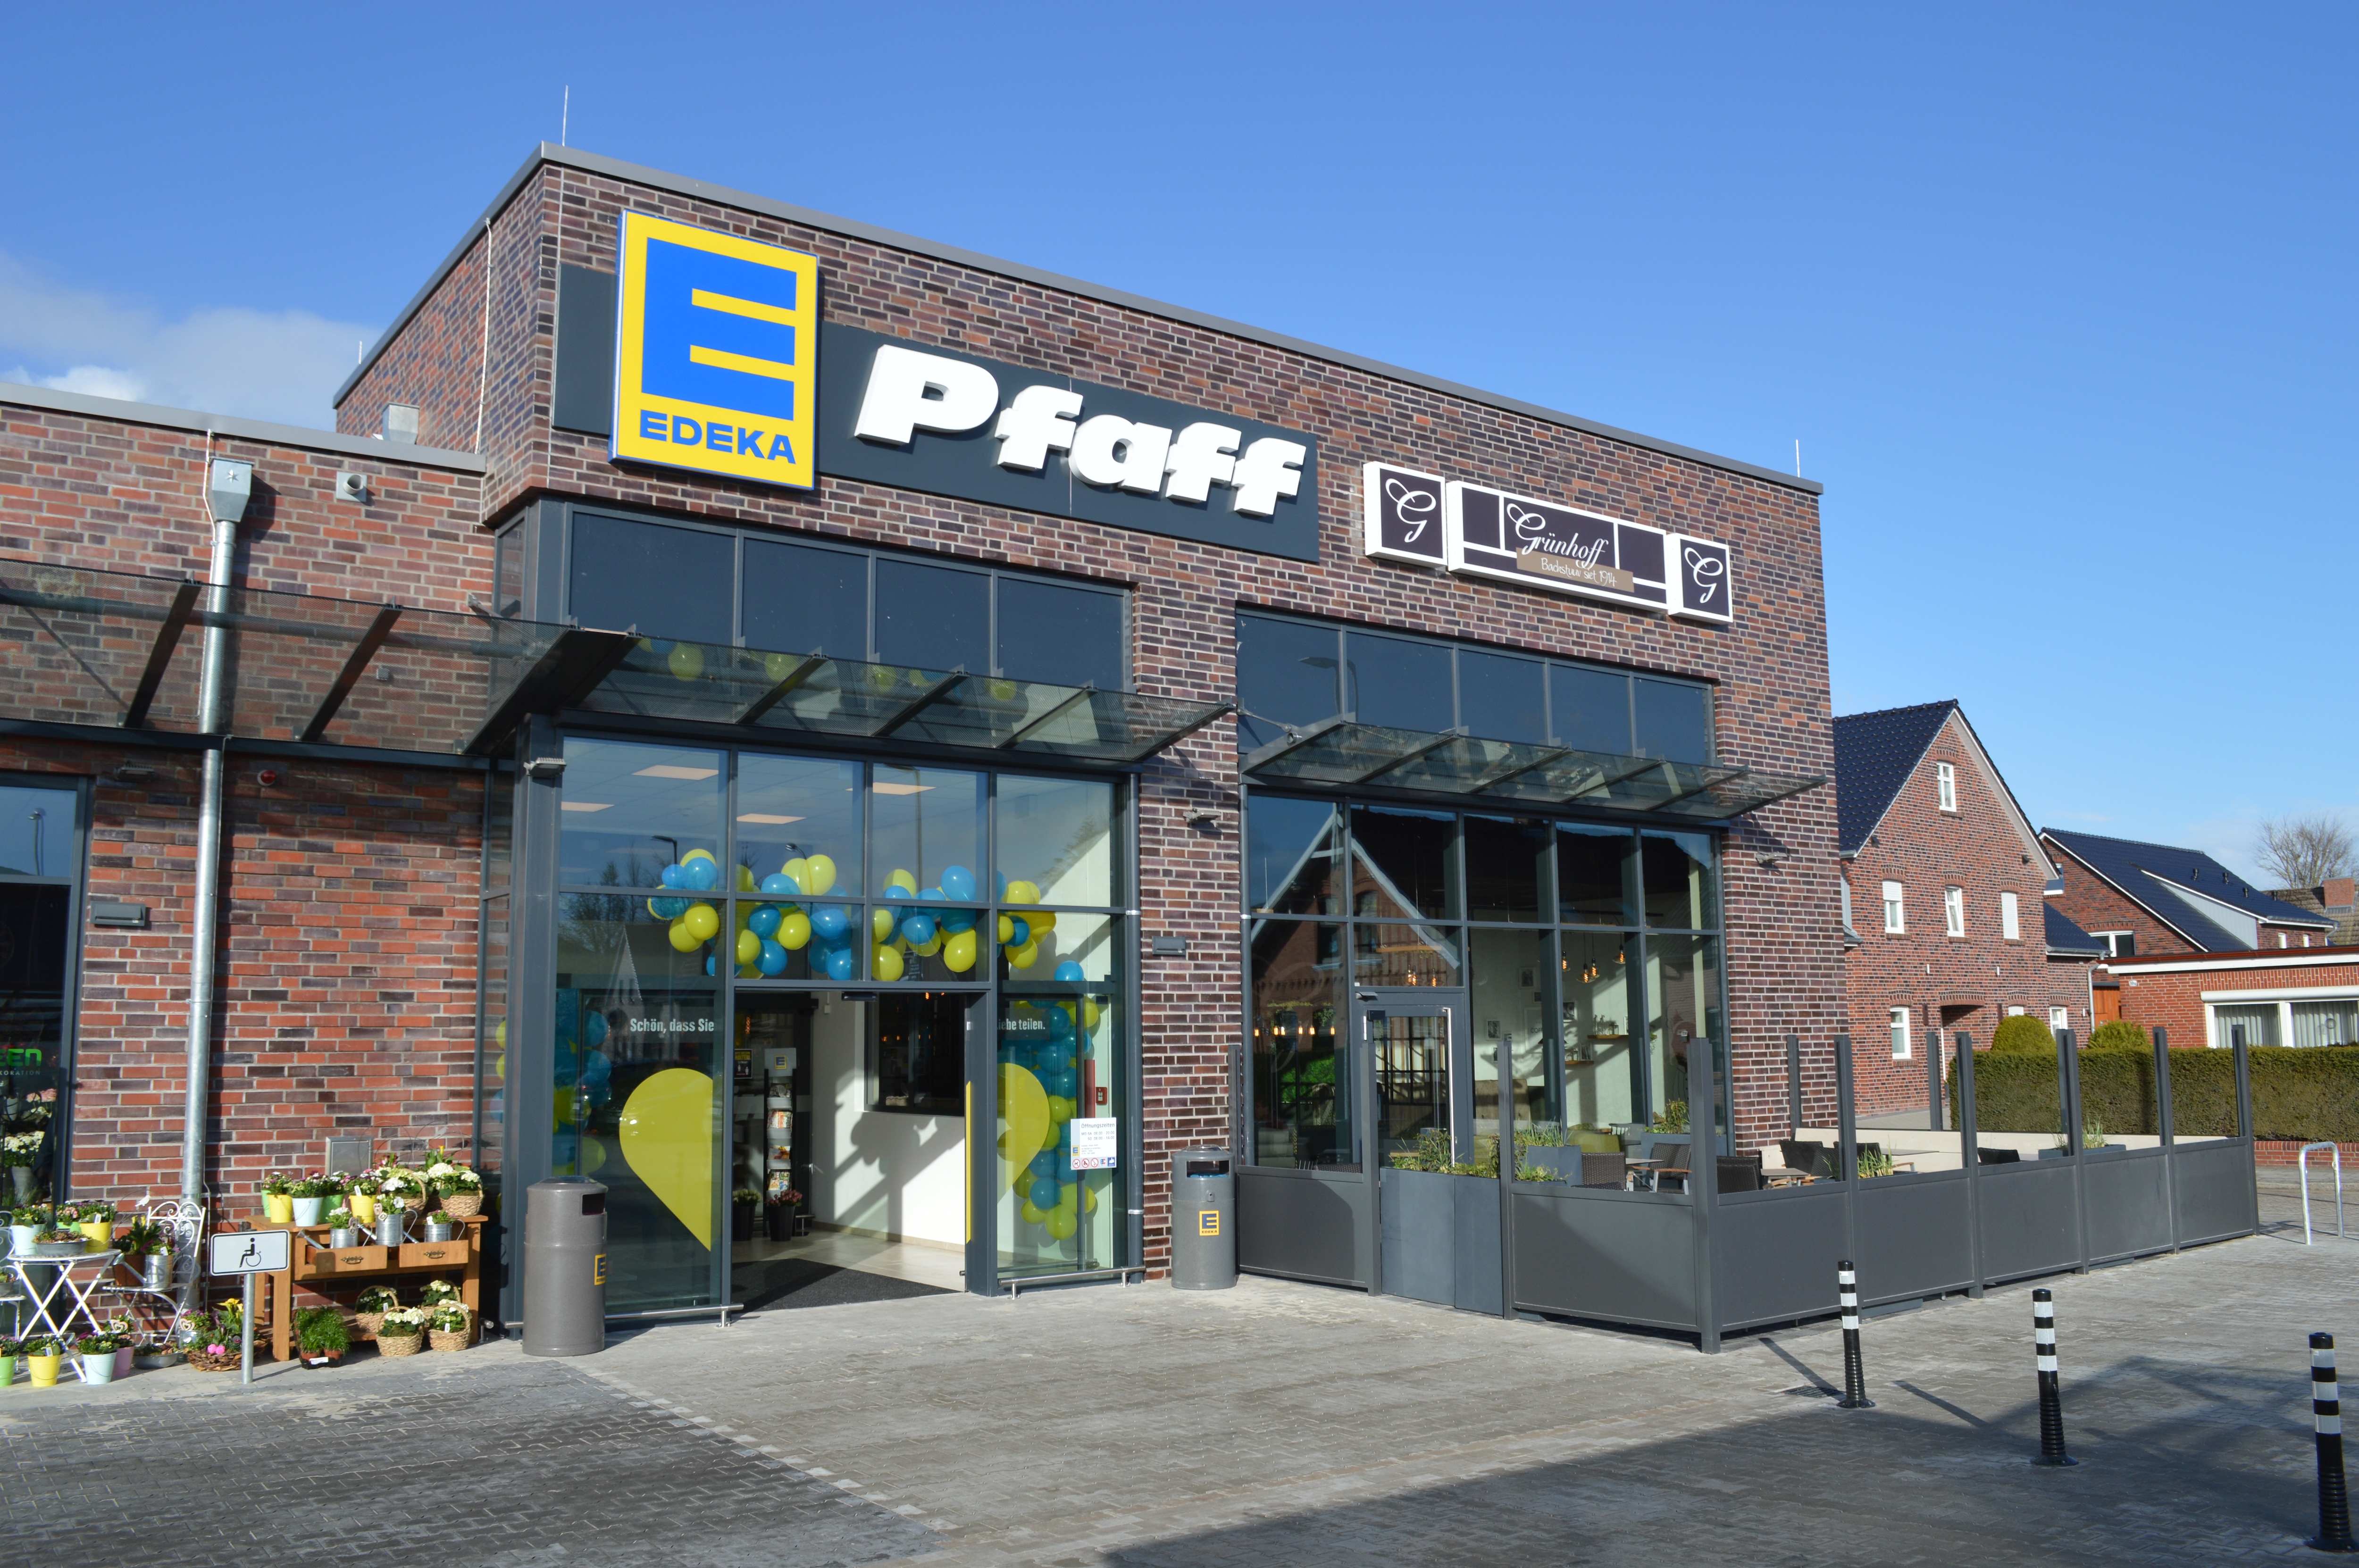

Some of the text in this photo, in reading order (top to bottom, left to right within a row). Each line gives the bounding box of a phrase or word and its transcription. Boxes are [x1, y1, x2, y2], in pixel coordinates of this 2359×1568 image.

[641, 236, 797, 421] E
[639, 409, 797, 465] EDEKA
[854, 344, 1307, 517] Pfaff
[1506, 503, 1609, 570] Grünhoff
[1599, 570, 1617, 587] 1914
[630, 1018, 714, 1034] Schön, dass Sie
[997, 1018, 1046, 1030] iebe teilen.
